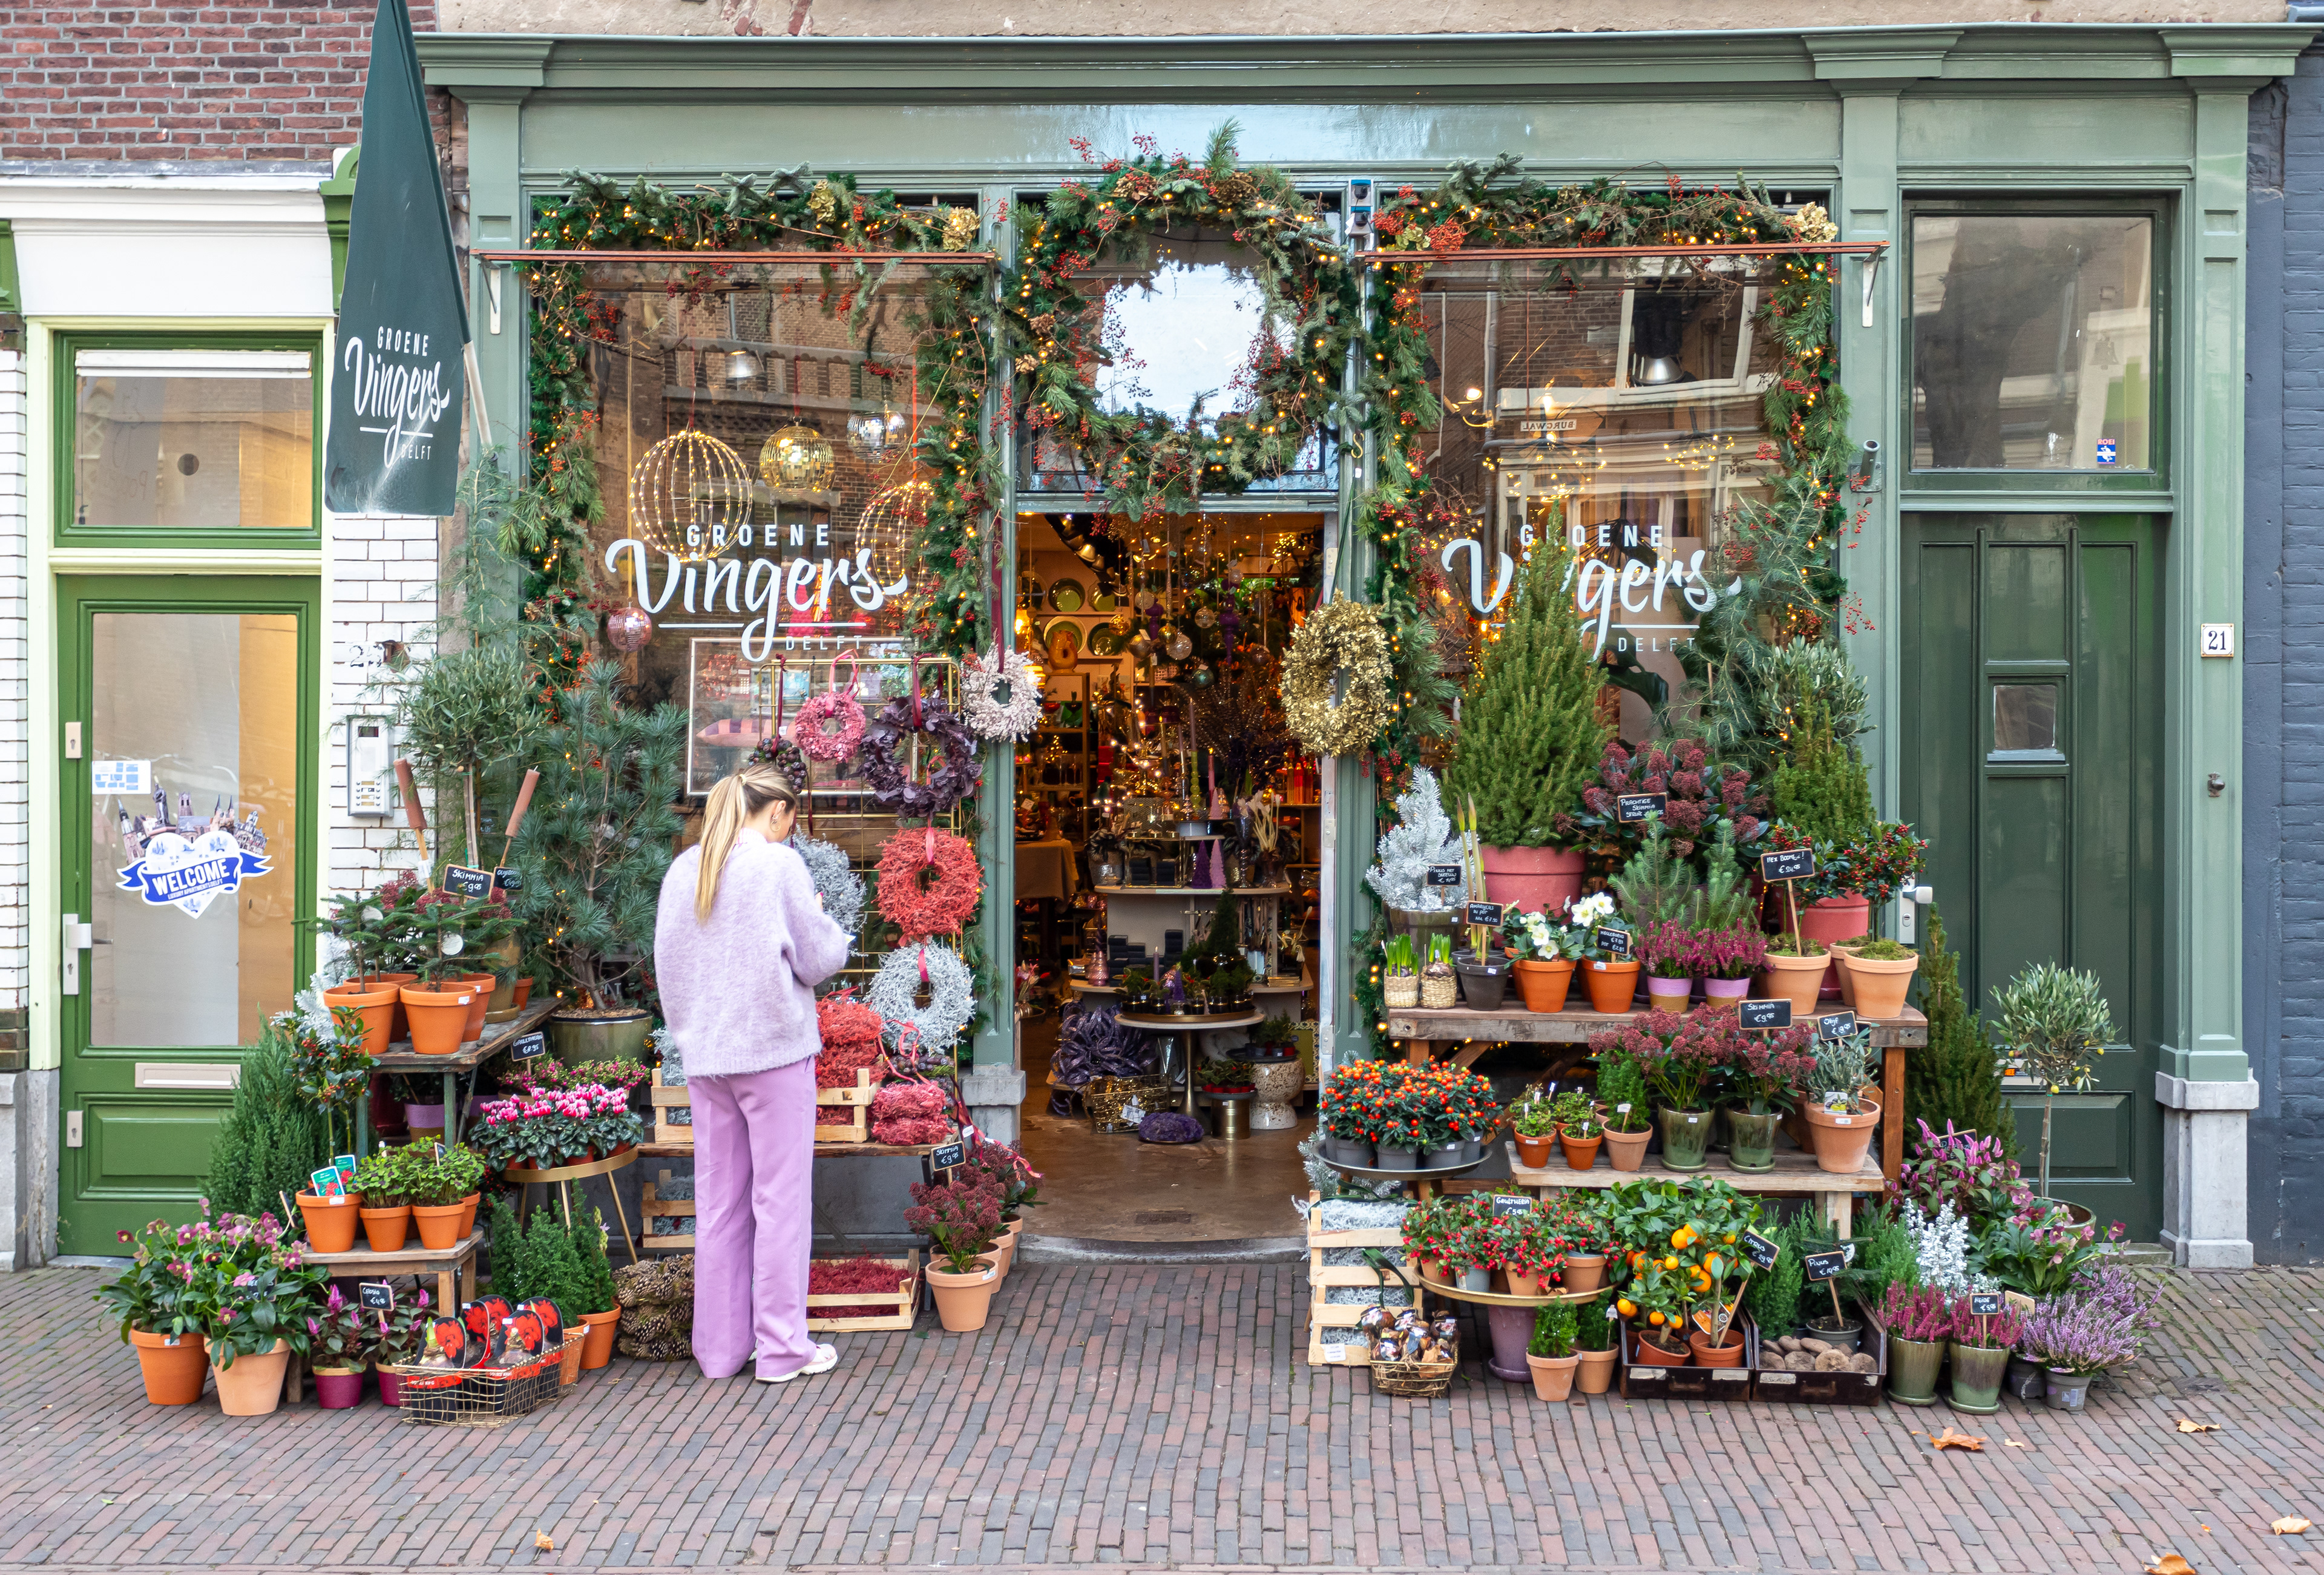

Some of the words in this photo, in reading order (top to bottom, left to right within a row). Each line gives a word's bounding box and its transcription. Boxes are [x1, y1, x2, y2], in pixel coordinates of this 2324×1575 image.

[377, 326, 429, 357] GROENE
[344, 337, 450, 469] Vingers
[401, 444, 432, 461] DELFT
[686, 524, 829, 547] GROENE
[1520, 524, 1663, 547] GOENE
[605, 538, 908, 663] Vingers
[1441, 539, 1742, 663] Vgers
[786, 635, 863, 651] DELFT
[1618, 637, 1696, 653] DELFT
[2208, 630, 2227, 650] 21
[151, 858, 230, 896] WELCOME
